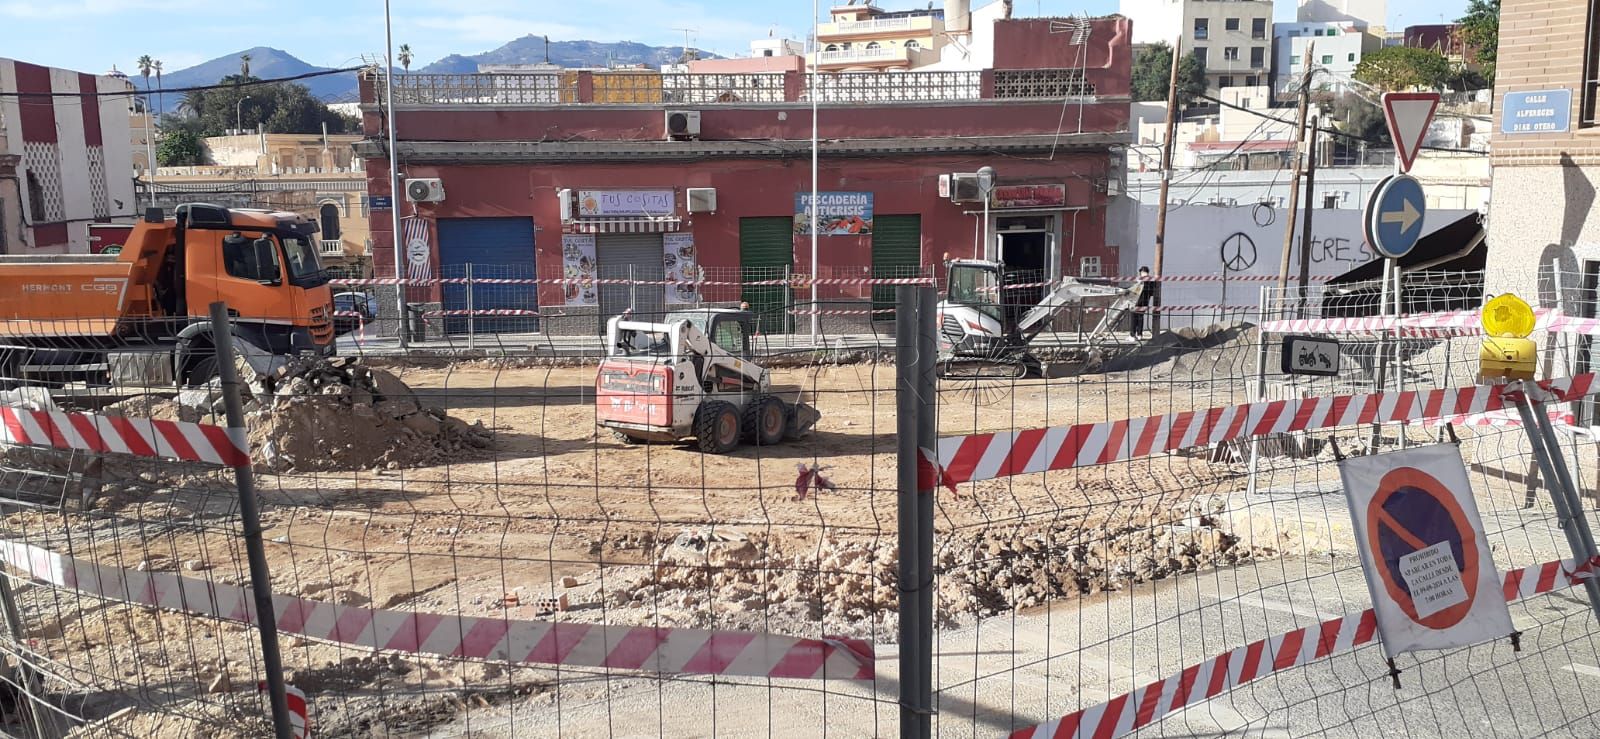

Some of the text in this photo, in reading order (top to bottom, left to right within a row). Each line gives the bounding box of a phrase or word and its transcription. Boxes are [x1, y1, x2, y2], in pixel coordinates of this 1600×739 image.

[1525, 95, 1547, 104] CALLE
[601, 192, 621, 207] TUS
[1409, 548, 1440, 564] PROHIBIDO
